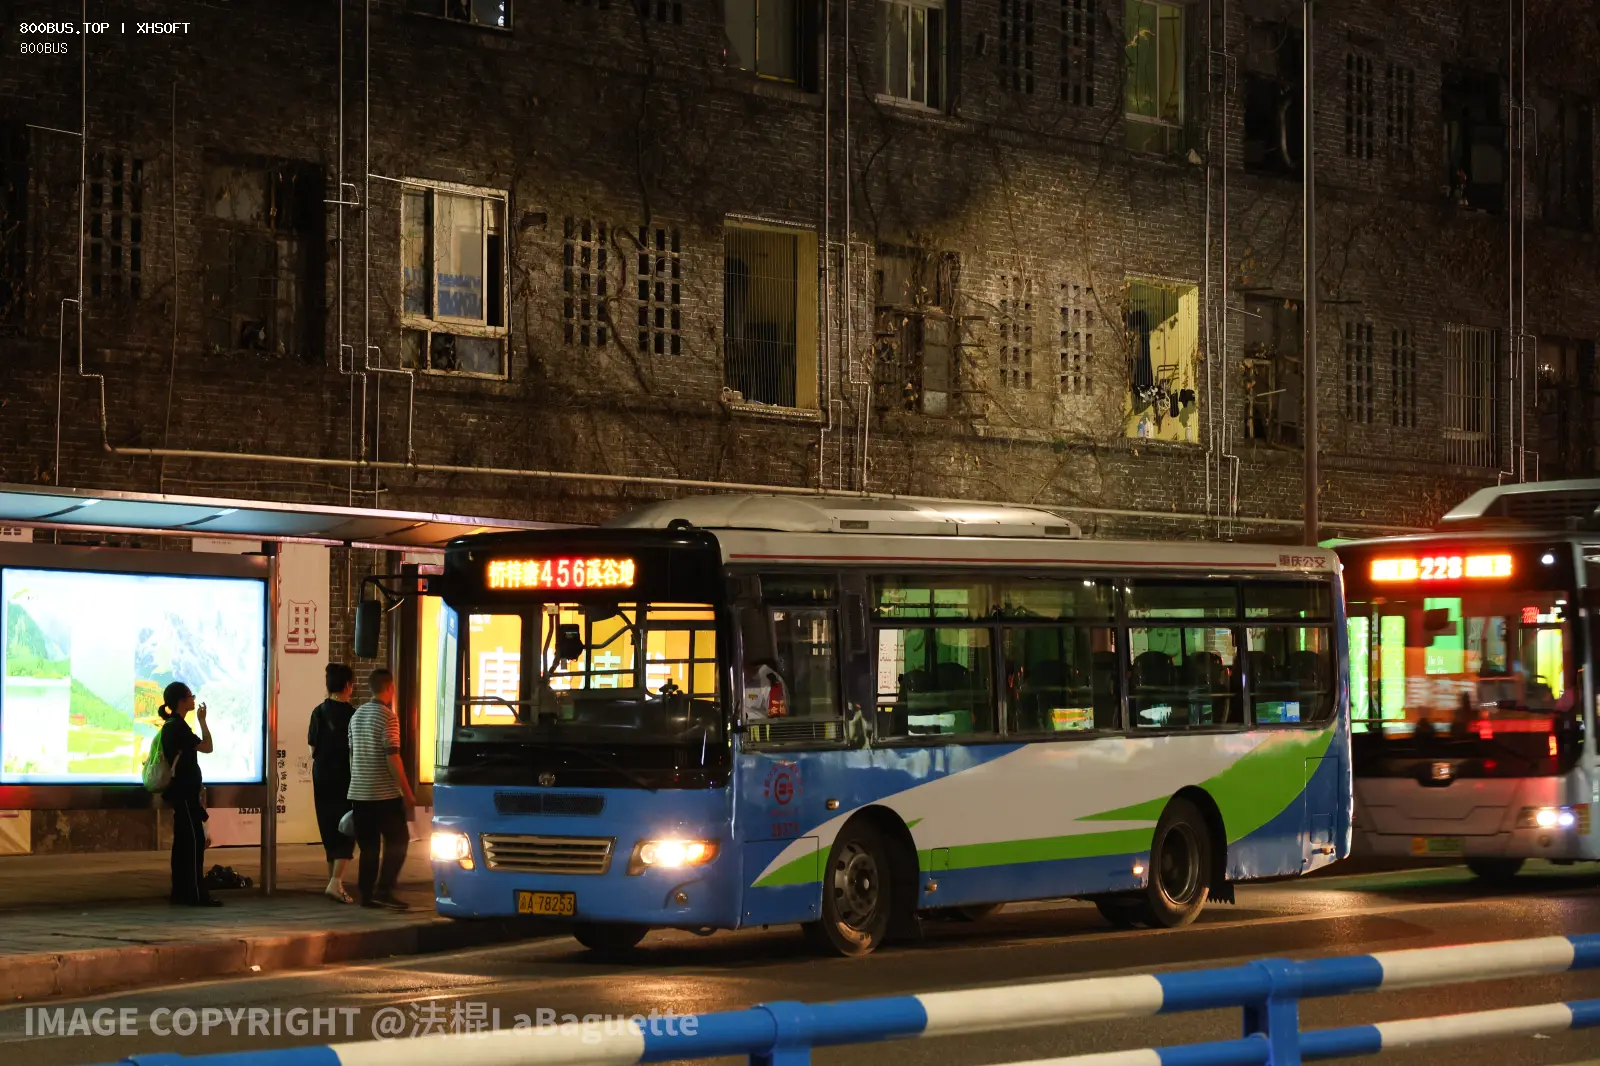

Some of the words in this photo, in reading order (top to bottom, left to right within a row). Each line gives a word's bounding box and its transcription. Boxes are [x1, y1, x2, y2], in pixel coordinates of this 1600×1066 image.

[1279, 555, 1326, 568] 重庆公交
[1419, 556, 1463, 580] 228
[541, 560, 585, 588] 456
